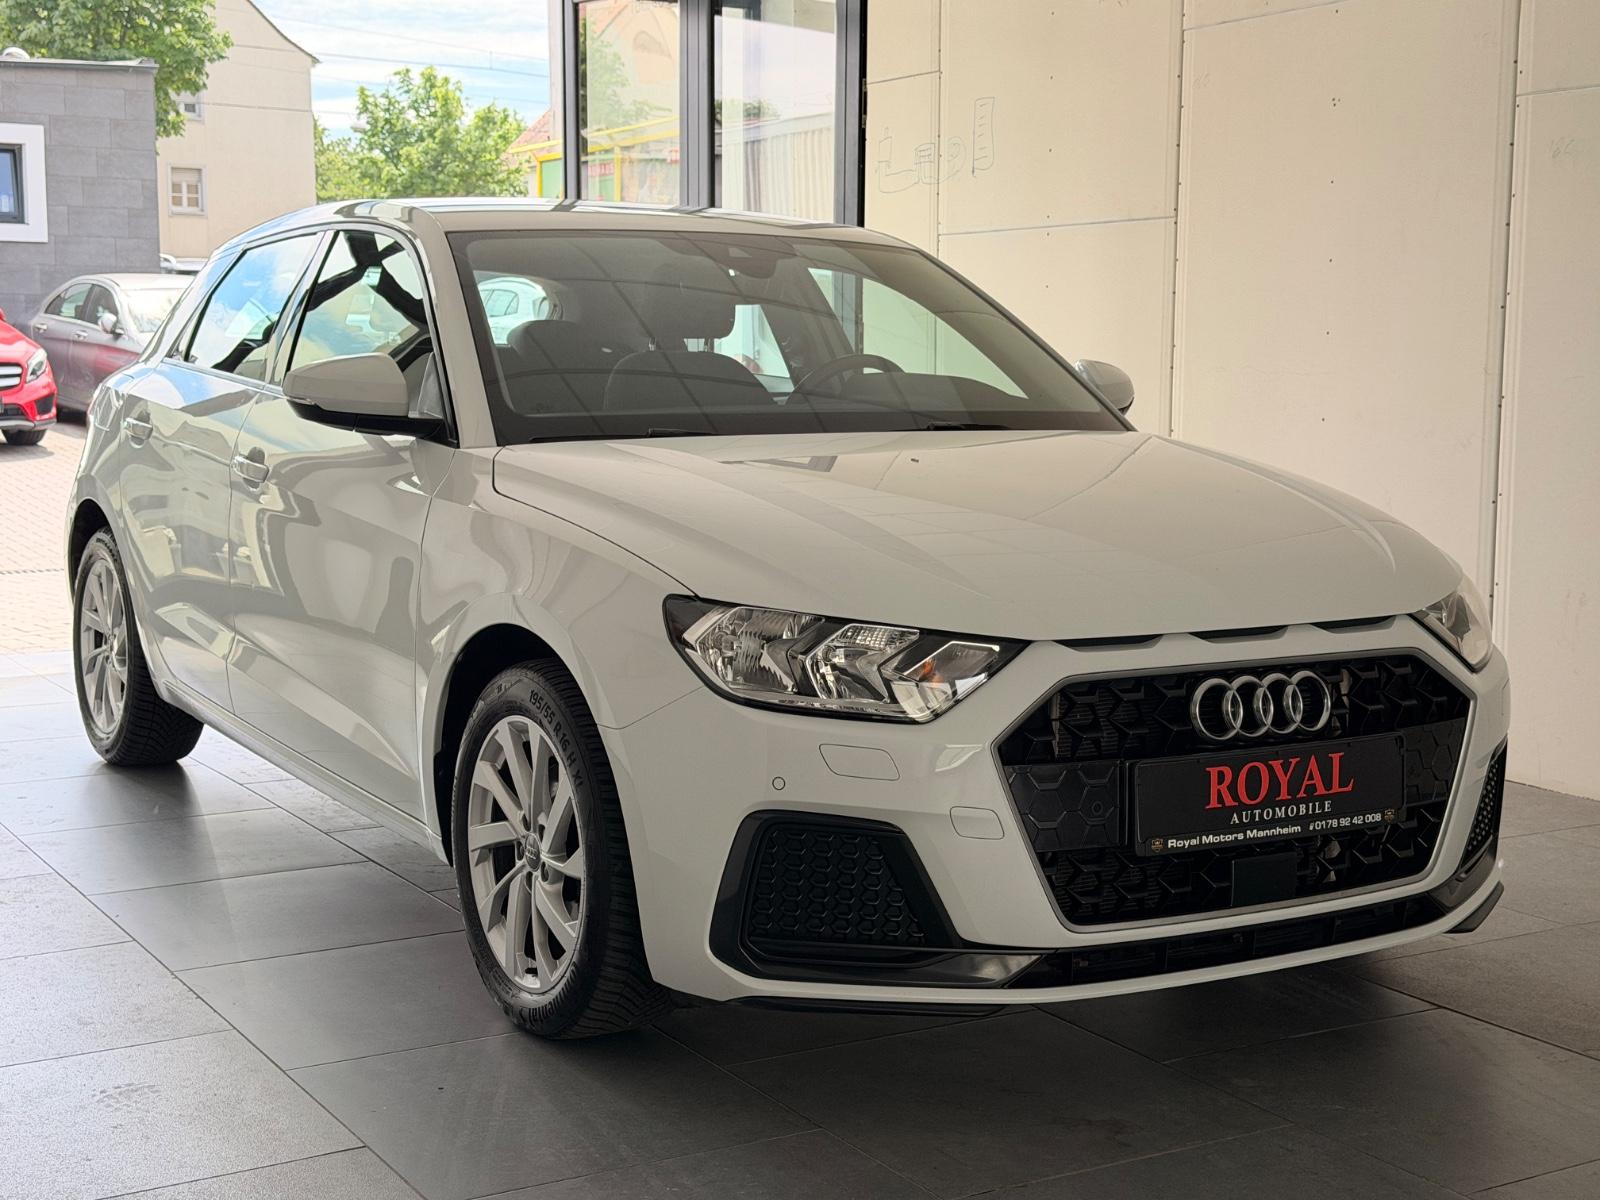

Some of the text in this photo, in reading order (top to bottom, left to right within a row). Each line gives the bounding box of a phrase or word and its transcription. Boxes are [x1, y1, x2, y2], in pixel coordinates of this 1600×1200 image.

[528, 689, 555, 725] 195/55
[1205, 752, 1354, 809] ROYAL
[1230, 800, 1333, 825] AUTOMOBILE
[1167, 837, 1200, 850] Royal
[1202, 832, 1245, 845] Motors
[1246, 825, 1302, 839] Mannheim
